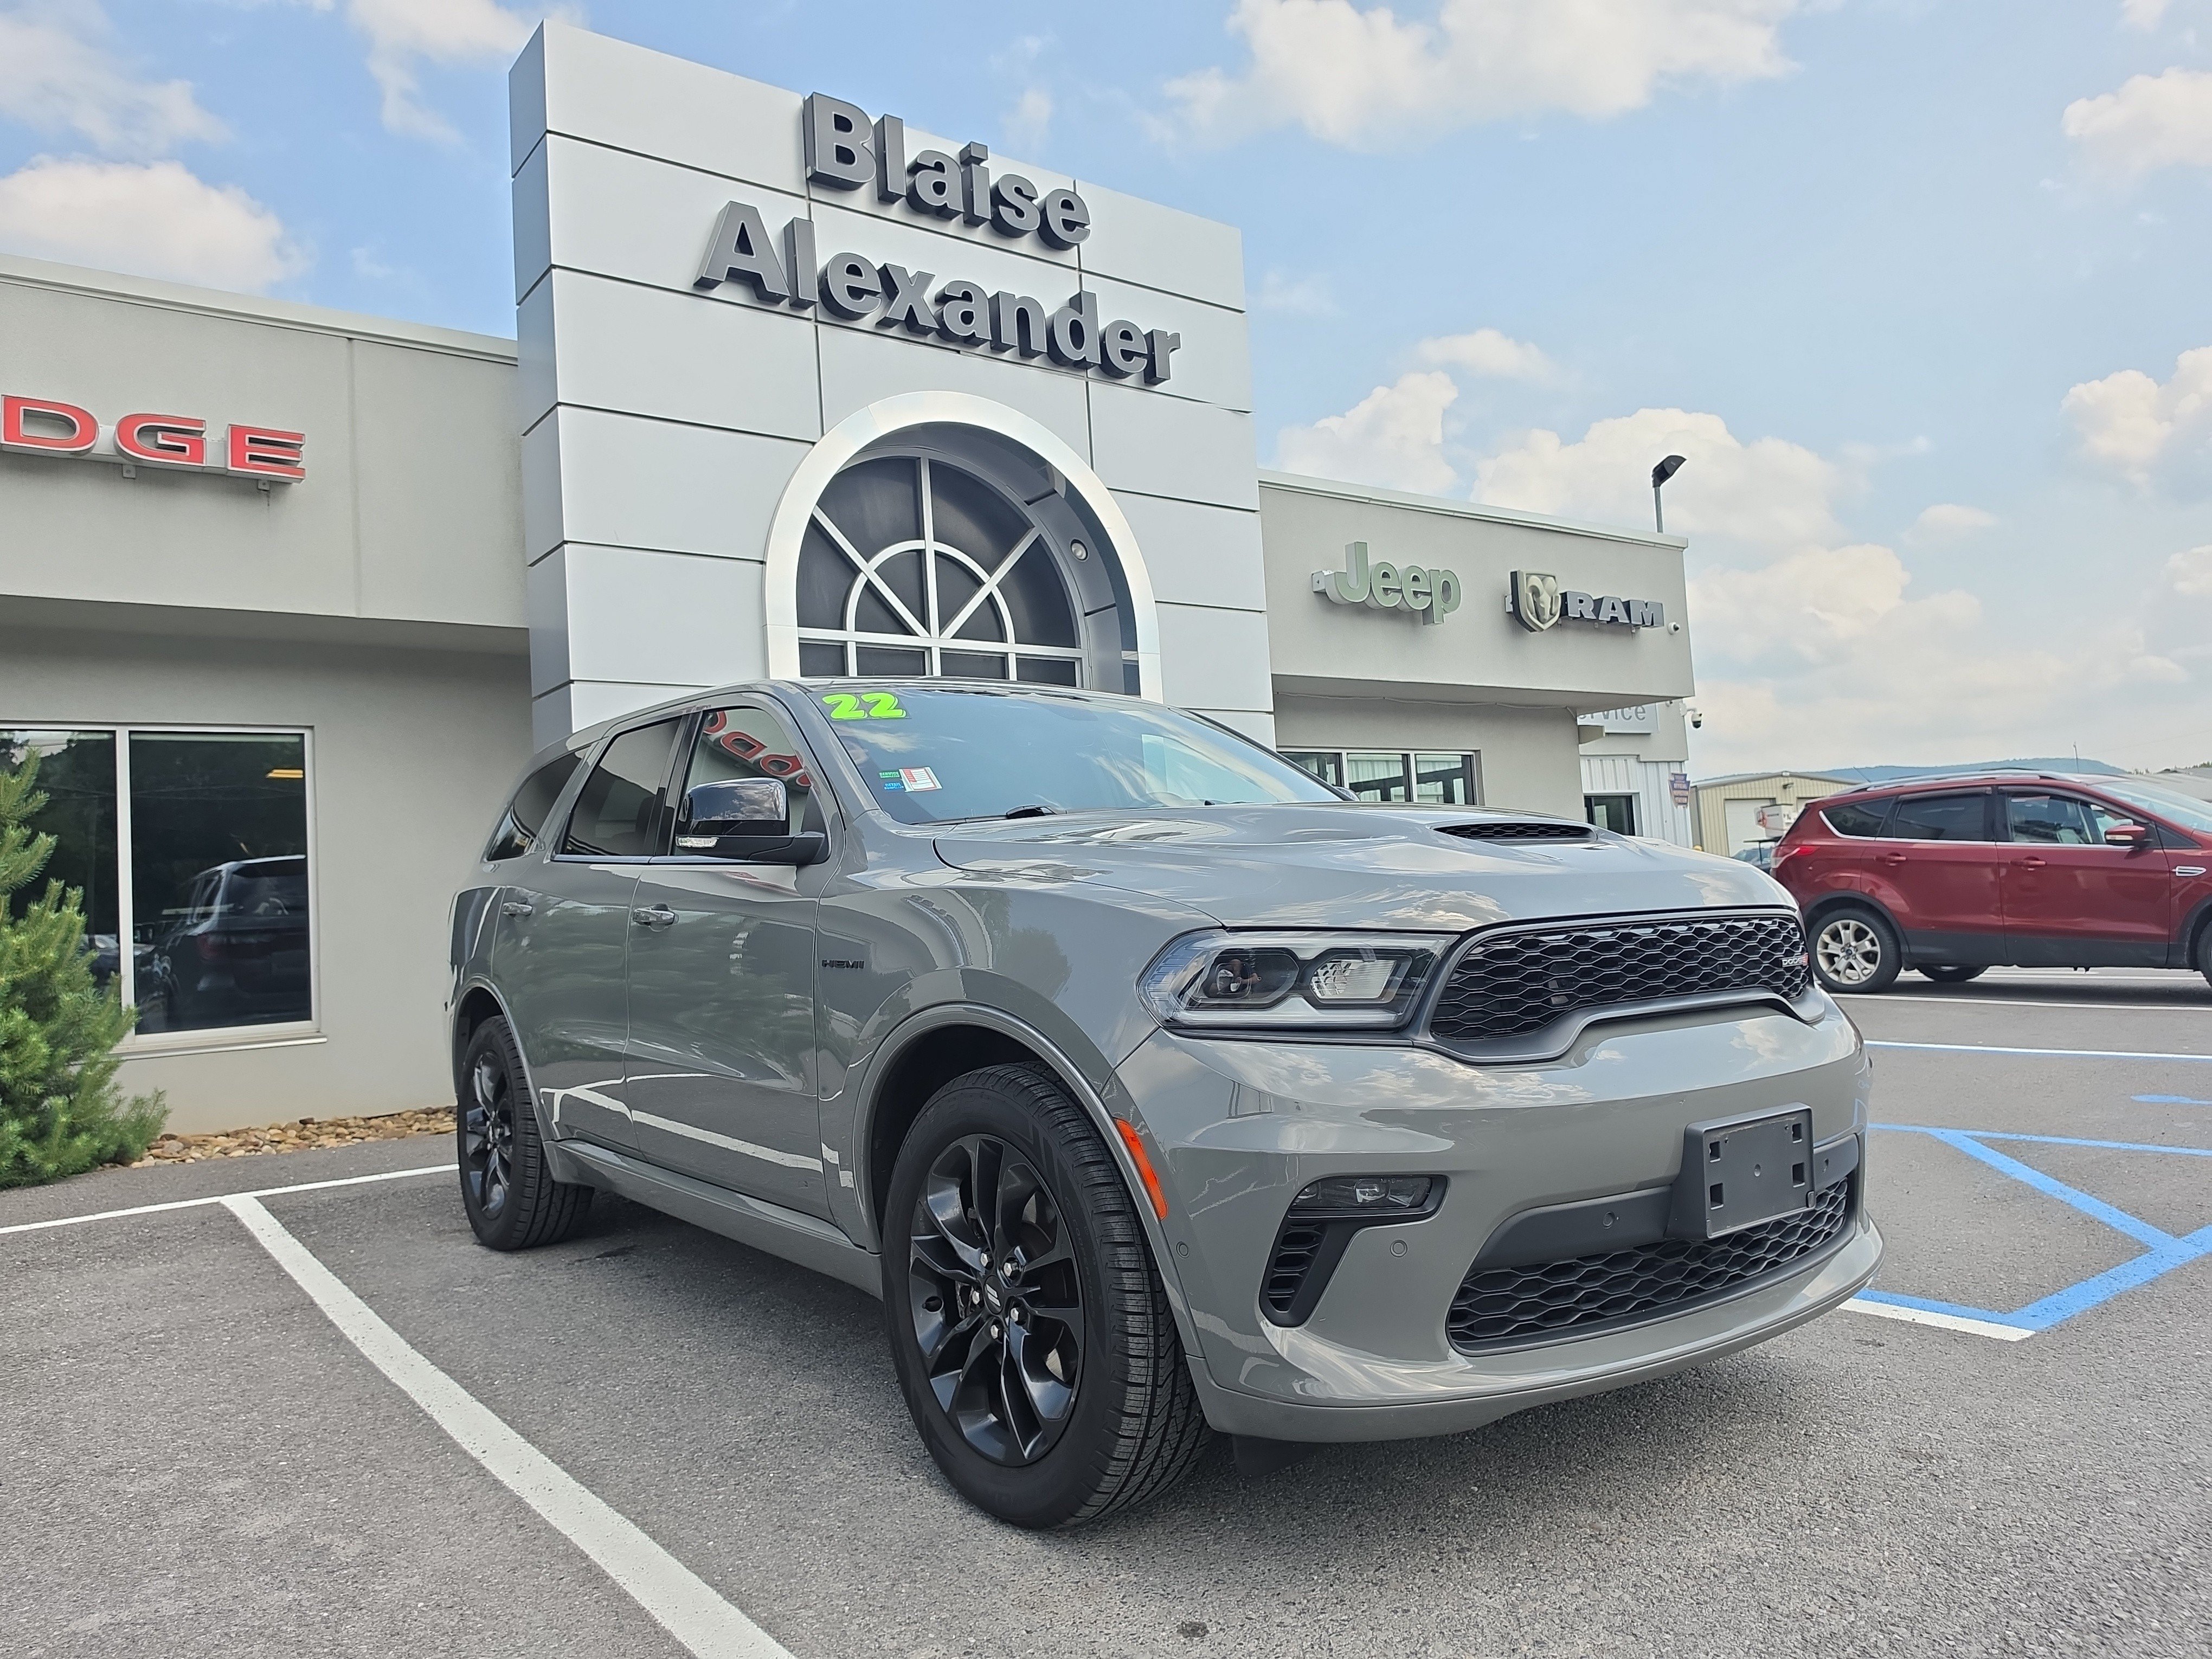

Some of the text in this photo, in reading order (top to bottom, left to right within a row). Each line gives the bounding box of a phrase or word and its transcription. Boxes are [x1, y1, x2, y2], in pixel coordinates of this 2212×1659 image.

[803, 92, 1091, 250] Blaise
[694, 201, 1180, 385] Alexander
[1326, 541, 1461, 625] Jeep
[1562, 591, 1664, 628] RAM
[822, 692, 906, 719] 22
[822, 960, 864, 969] HEMI
